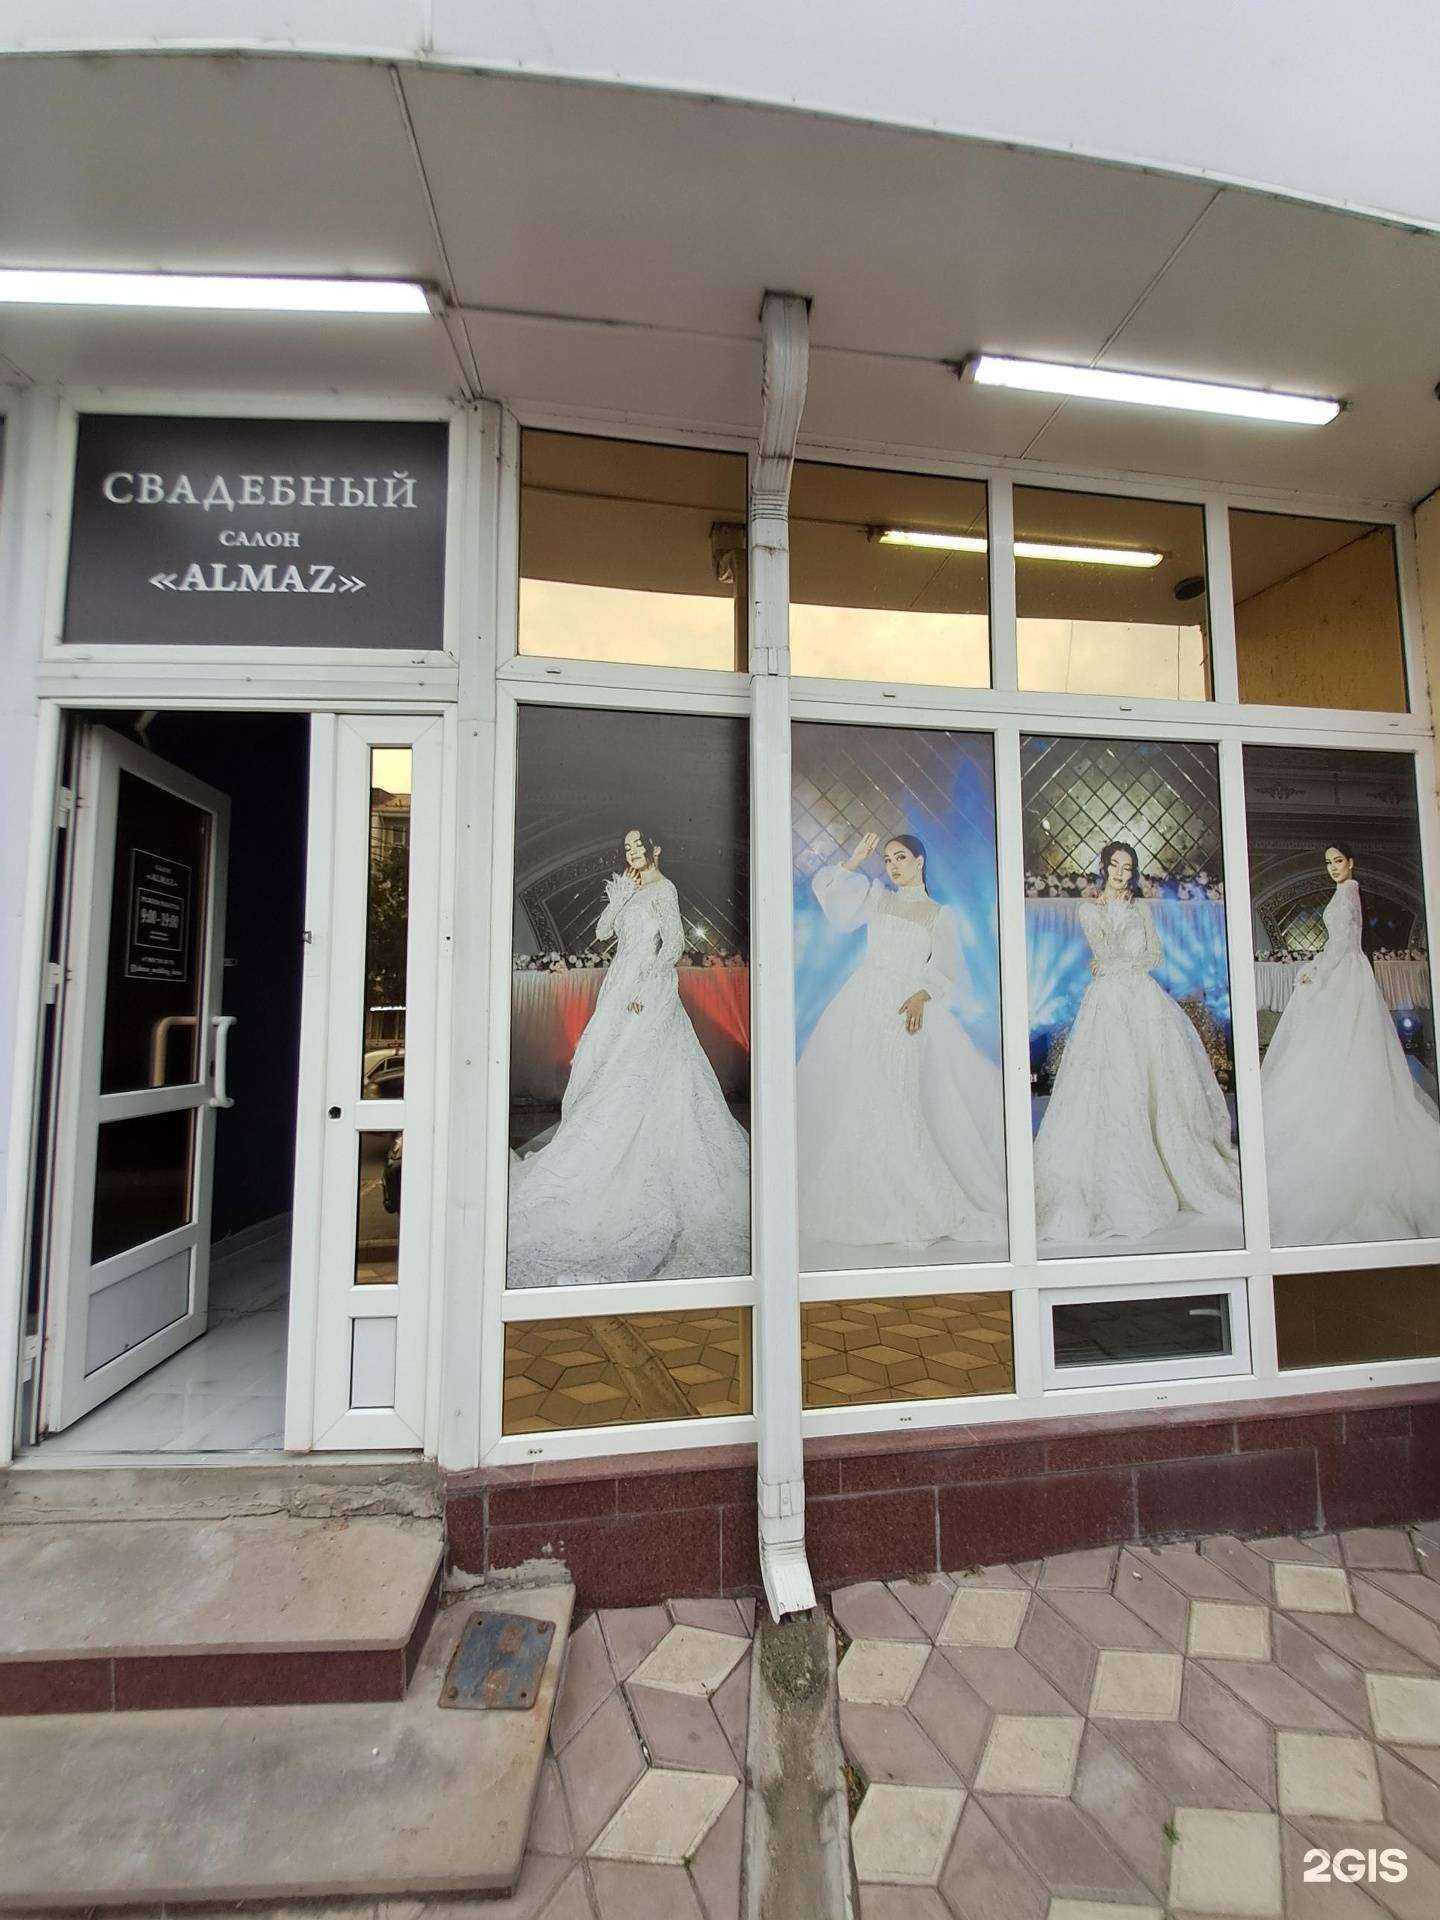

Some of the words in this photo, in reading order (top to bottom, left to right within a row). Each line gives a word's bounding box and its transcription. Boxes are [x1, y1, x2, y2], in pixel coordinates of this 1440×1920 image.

[102, 470, 418, 512] СВАДЕБНЫЙ
[218, 529, 301, 548] САЛОН
[149, 562, 367, 593] «ALMAZ»
